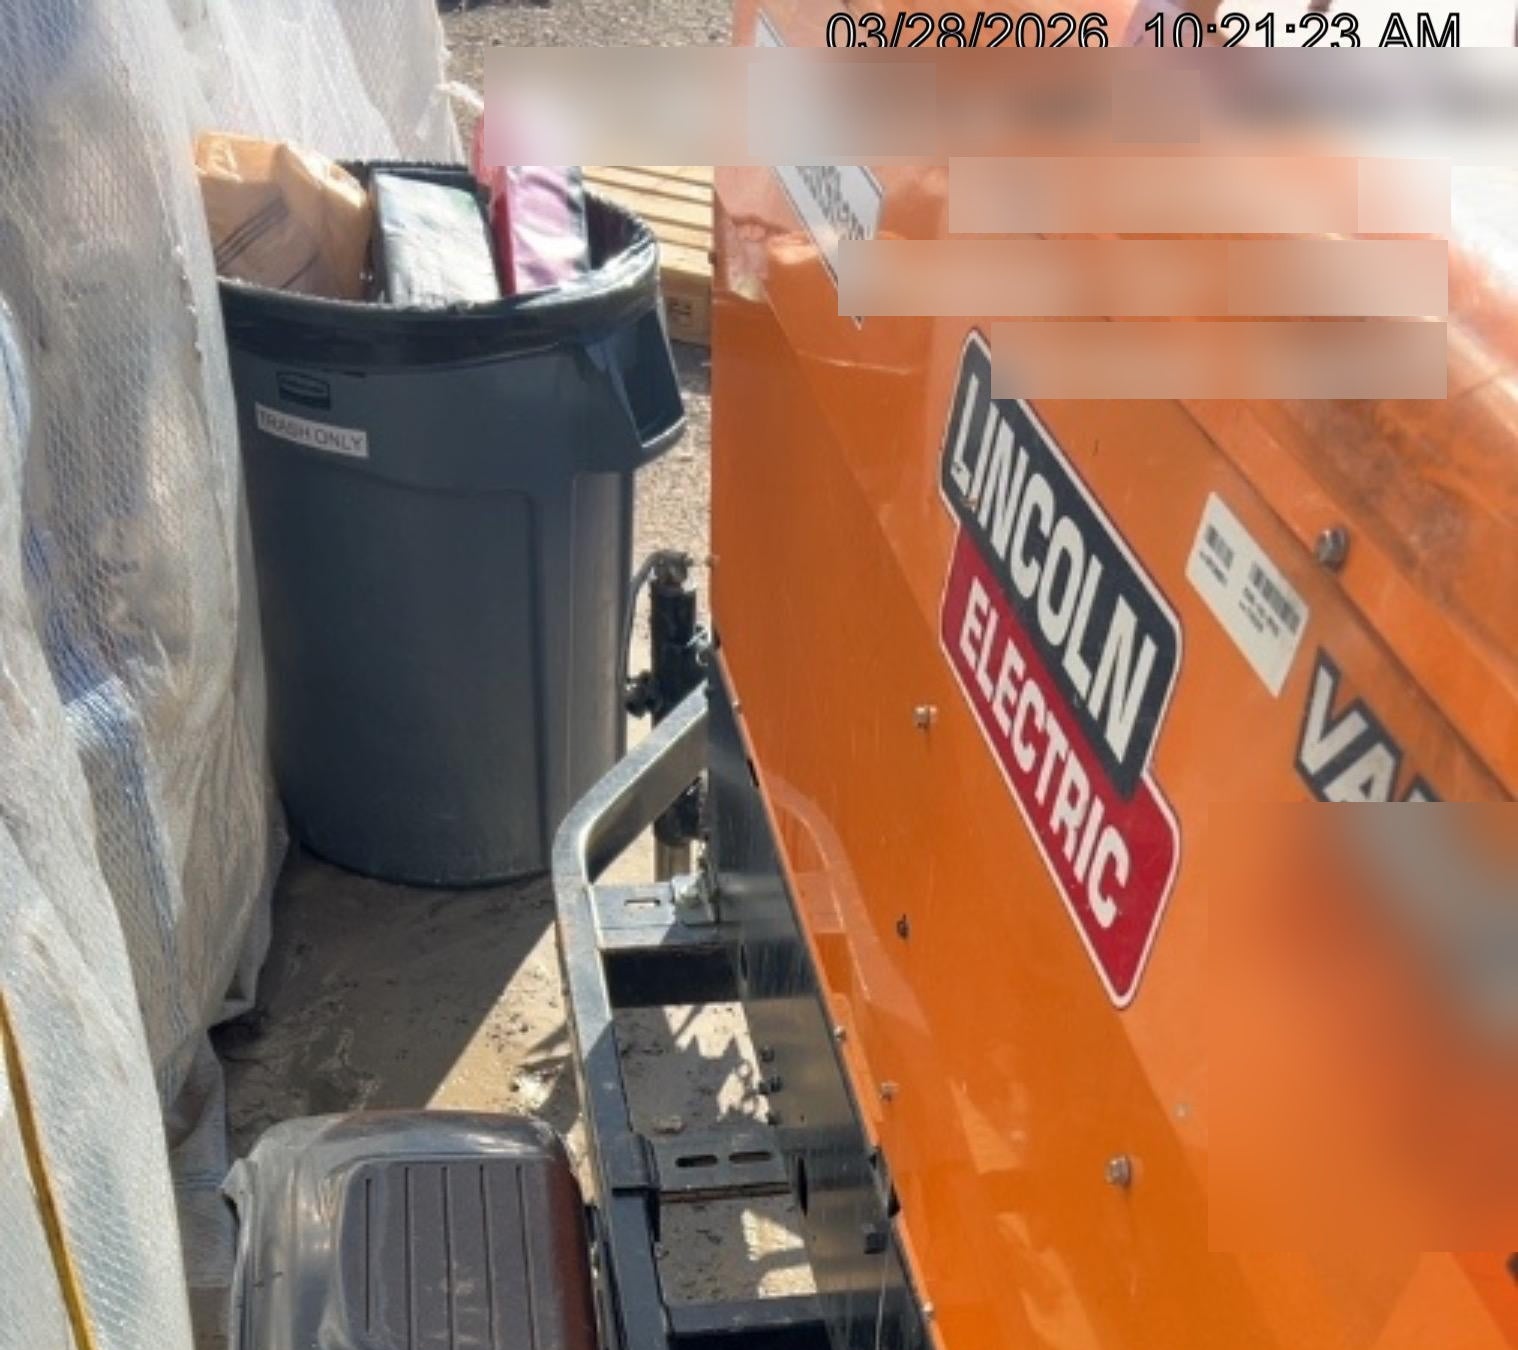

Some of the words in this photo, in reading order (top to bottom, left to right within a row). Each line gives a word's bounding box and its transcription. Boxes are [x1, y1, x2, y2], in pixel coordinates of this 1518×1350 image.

[258, 409, 311, 441] TRASH
[314, 428, 364, 451] ONLY
[949, 373, 1159, 764] LINCOLN
[958, 575, 1131, 929] ELECTRIC
[1298, 655, 1434, 802] VA
